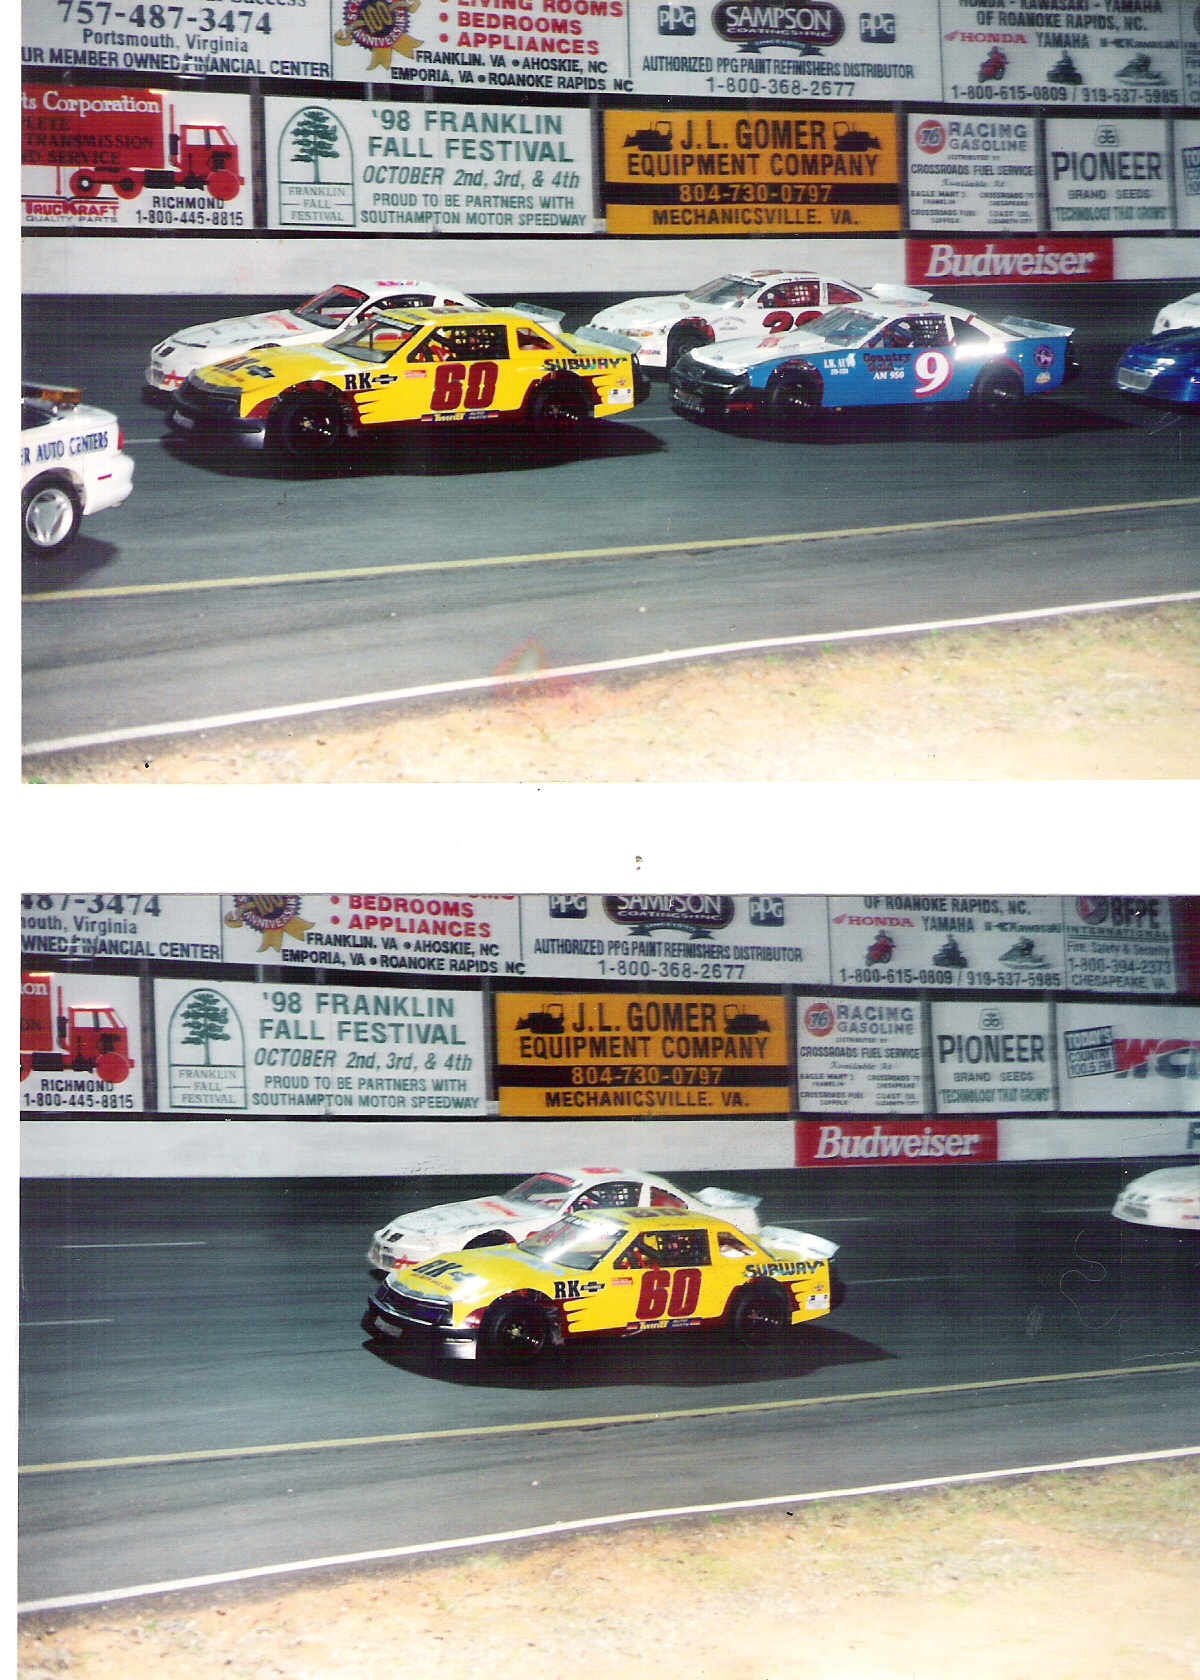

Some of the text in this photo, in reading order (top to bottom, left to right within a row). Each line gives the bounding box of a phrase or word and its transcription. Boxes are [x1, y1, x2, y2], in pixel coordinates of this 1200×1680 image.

[58, 0, 272, 35] 757-487-3474
[543, 0, 624, 17] ROOMS
[457, 11, 582, 35] BEDROOMS
[726, 6, 832, 31] SAMPSON
[977, 11, 1060, 28] OF ROANOKE
[82, 28, 249, 53] Portsmouth, Virginia
[457, 32, 599, 55] APPLIANCES
[961, 32, 1089, 49] HONDA YAMAHA
[50, 48, 330, 77] MEMBER OWNED FINANCIAL CENTER
[490, 54, 608, 75] VA AHOSKIE, NC
[643, 55, 914, 79] AUTHORIZED PPG PAINT REFINISHERS DISTRIBUTOR
[390, 67, 634, 93] EMPORIA, VA ROANOKE RAPIDS NC
[706, 77, 856, 97] 1-800-368-2677
[952, 85, 1066, 101] 1-800-615-0809
[43, 90, 161, 117] Corporation
[371, 109, 562, 135] '98 FRANKLIN
[948, 121, 1027, 139] RACING
[680, 119, 826, 150] J.L. GOMER
[918, 127, 940, 146] 76
[368, 136, 574, 163] FALL FESTIVAL
[949, 138, 1027, 152] GASOLINE
[627, 153, 878, 177] EQUIPMENT COMPANY
[911, 164, 1034, 176] CROSSROADS FUEL SERVICE
[1051, 151, 1162, 181] PIONEER
[362, 165, 580, 191] OCTOBER 2nd, 3rd, & 4th
[288, 186, 346, 197] FRANKLIN
[679, 184, 832, 203] 804-730-0797
[1068, 188, 1151, 200] BRAND SEEDS
[153, 196, 224, 210] RICHMOND
[303, 198, 332, 209] FALL
[373, 193, 574, 210] PROUD TO BE PARTNERS WITH
[25, 215, 72, 223] QUALITY
[136, 211, 243, 226] 1-800-445-8815
[291, 211, 344, 222] FESTIVAL
[360, 210, 586, 227] SOUTHAMPTON MOTOR SPEEDWAY
[831, 208, 859, 225] VA.
[925, 244, 1095, 278] Budweiser
[543, 358, 620, 372] SUBWAY
[914, 350, 953, 397] 9
[344, 372, 372, 390] RK
[873, 371, 905, 381] AM 950
[430, 362, 499, 411] 60
[36, 431, 109, 462] AUTO CENTERS
[349, 895, 474, 918] BEDROOMS
[618, 895, 721, 915] SAMPSON
[885, 896, 947, 912] ROANOKE
[73, 915, 137, 936] Virginia
[348, 914, 491, 938] APPLIANCES
[849, 916, 975, 933] HONDA YAMAHA
[71, 935, 220, 960] FINANCIAL CENTER
[381, 937, 499, 958] VA AHOSKIE, NC
[534, 938, 803, 963] AUTHORIZED PPG PAINT REFINISHERS DISTRIBUTOR
[281, 948, 526, 975] EMPORIA, VA ROANOKE RAPIDS NC
[598, 960, 745, 980] 1-800-368-2677
[840, 968, 1061, 986] 1-800-615-0809 919-537-5985
[263, 991, 454, 1017] '98 FRANKLIN
[837, 1004, 914, 1022] RACING
[572, 1002, 717, 1033] J.L. GOMER
[809, 1011, 830, 1030] 76
[259, 1018, 466, 1045] FALL FESTIVAL
[837, 1021, 915, 1035] GASOLINE
[520, 1036, 769, 1060] EQUIPMENT COMPANY
[800, 1046, 920, 1059] CROSSROADS FUEL SERVICE
[937, 1034, 1045, 1064] PIONEER
[254, 1048, 473, 1073] OCTOBER 2nd, 3rd, & 4th
[178, 1069, 237, 1080] FRANKLIN
[571, 1067, 723, 1085] 804-730-0797
[953, 1071, 1034, 1082] BRAND SEEDS
[41, 1078, 114, 1092] RICHMOND
[193, 1082, 223, 1091] FALL
[264, 1076, 467, 1093] PROUD TO BE PARTNERS WITH
[23, 1093, 134, 1108] 1-800-445-8815
[181, 1094, 236, 1104] FESTIVAL
[252, 1092, 480, 1109] SOUTHAMPTON MOTOR SPEEDWAY
[814, 1125, 979, 1159] Budweiser
[745, 1262, 818, 1278] SUBWAY
[554, 1280, 581, 1299] RK
[635, 1268, 702, 1319] 60
